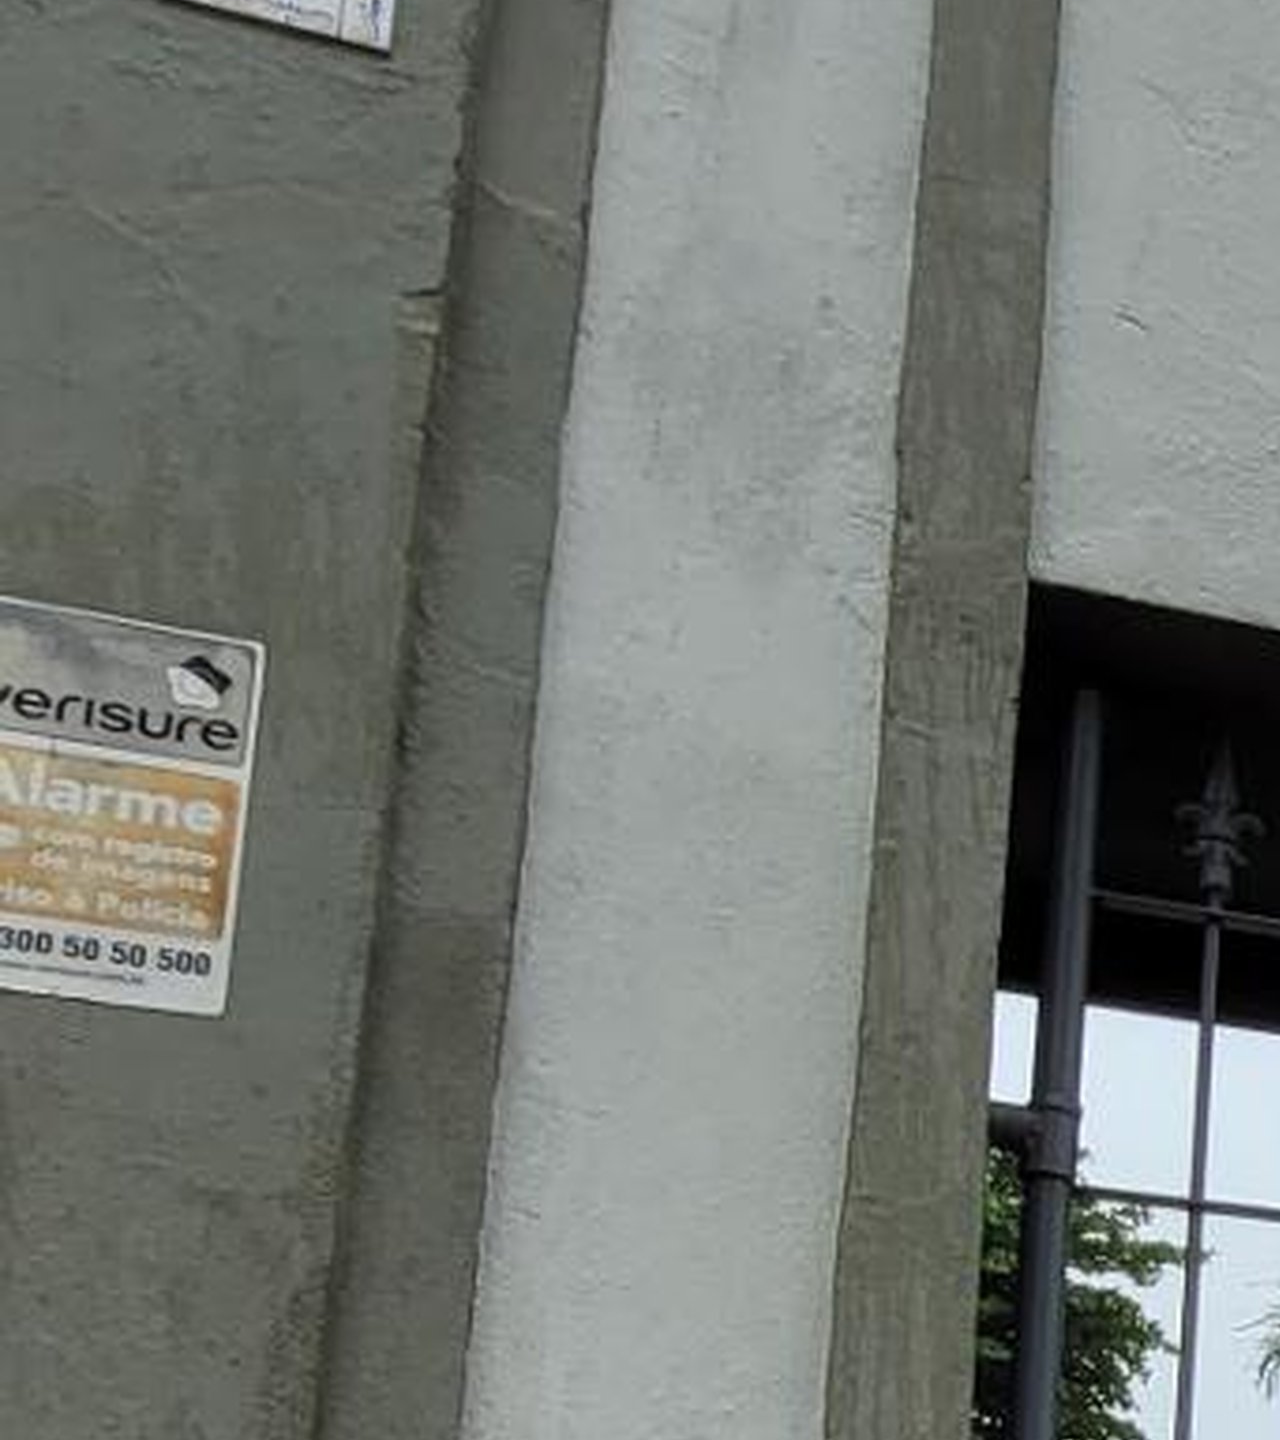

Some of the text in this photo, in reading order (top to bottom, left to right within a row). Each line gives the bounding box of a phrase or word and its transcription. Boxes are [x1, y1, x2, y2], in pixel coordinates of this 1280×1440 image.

[62, 934, 100, 962] 50
[108, 941, 147, 969] 50
[156, 946, 212, 976] 500
